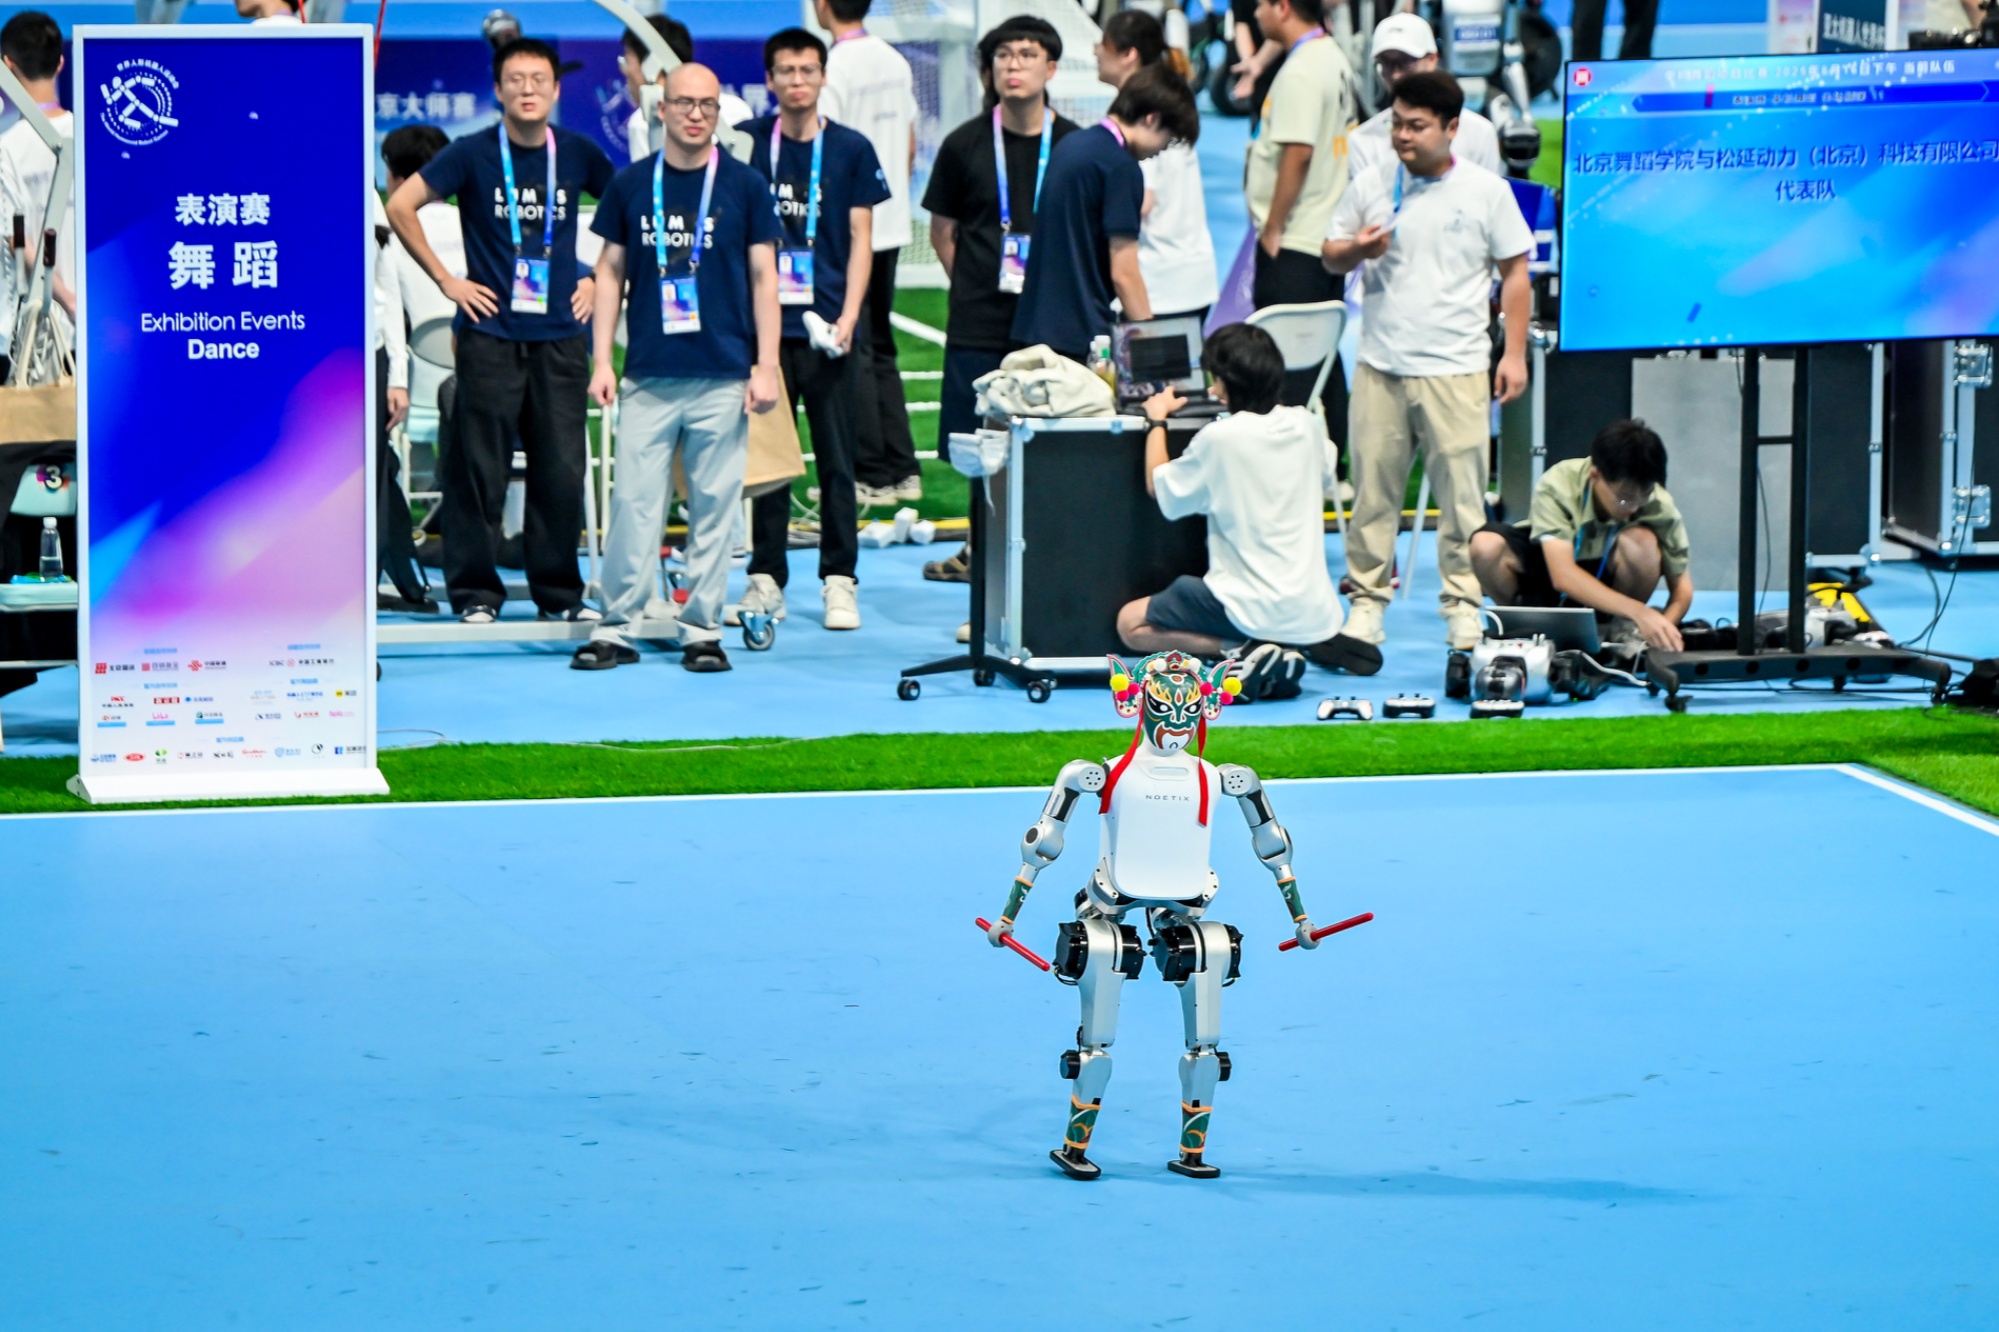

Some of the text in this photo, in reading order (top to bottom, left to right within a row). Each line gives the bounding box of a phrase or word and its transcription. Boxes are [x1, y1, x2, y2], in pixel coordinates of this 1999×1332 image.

[1775, 179, 1836, 201] 代表队
[174, 192, 270, 227] 表演赛
[141, 310, 306, 332] Exhibition Events
[187, 338, 260, 360] Dance
[44, 464, 63, 490] 3
[1145, 794, 1190, 802] NOETIX
